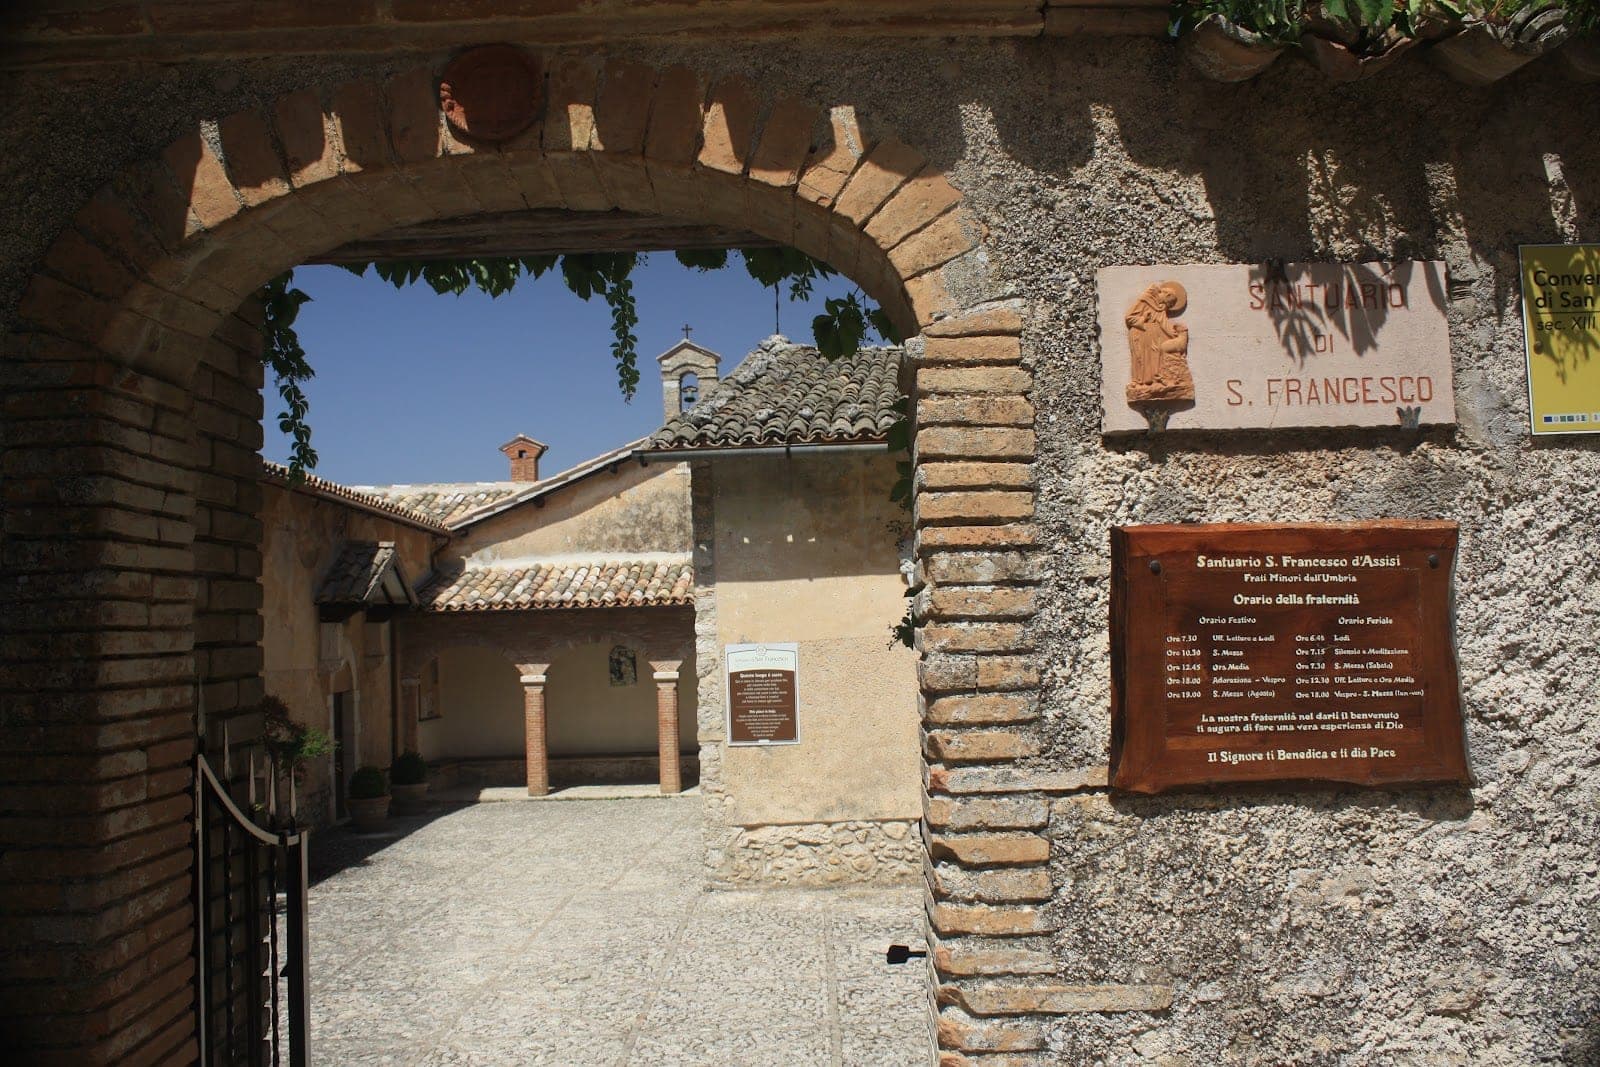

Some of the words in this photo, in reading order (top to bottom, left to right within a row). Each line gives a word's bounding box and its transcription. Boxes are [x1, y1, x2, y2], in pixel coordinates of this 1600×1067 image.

[1250, 284, 1404, 311] SANTUARIO
[1535, 292, 1552, 309] di
[1560, 292, 1595, 308] San
[1537, 319, 1566, 331] sec.
[1571, 317, 1596, 330] XIII
[1315, 334, 1334, 353] DI
[1227, 380, 1253, 406] S.
[1267, 377, 1433, 406] FRANCESCO
[1197, 555, 1261, 569] Santuario
[1265, 556, 1278, 568] S.
[1282, 556, 1348, 568] Francesco
[1352, 554, 1401, 567] d'Assisi
[1244, 573, 1266, 583] Frati
[1270, 573, 1301, 583] Minori
[1304, 573, 1357, 583] dell'Umbria
[1234, 594, 1272, 605] Orario
[1276, 594, 1303, 605] della
[1307, 594, 1360, 605] fraternità
[1199, 616, 1226, 624] Orario
[1228, 616, 1256, 624] Festivo
[1338, 617, 1364, 625] Orario
[1296, 648, 1309, 656] Ore
[1213, 664, 1227, 672] Ora
[1227, 663, 1250, 671] Media
[1262, 676, 1286, 684] Vespro
[1296, 677, 1309, 685] Ore
[1296, 691, 1309, 699] Ore
[1334, 691, 1357, 699] Vespro
[1201, 714, 1216, 723] La
[1218, 714, 1249, 723] nostra
[1251, 713, 1296, 722] fraternità
[1299, 713, 1314, 721] nel
[1316, 712, 1339, 721] darti
[1342, 712, 1348, 720] il
[1350, 712, 1400, 720] benvenuto
[1197, 725, 1204, 733] ti
[1207, 726, 1240, 735] augura
[1243, 723, 1252, 732] di
[1255, 723, 1274, 732] fare
[1277, 724, 1295, 732] una
[1321, 722, 1372, 732] esperienza
[1386, 721, 1403, 730] Dio
[1208, 752, 1217, 763] Il
[1220, 751, 1263, 765] Signore
[1266, 751, 1274, 761] ti
[1277, 749, 1328, 761] Benedica
[1331, 751, 1337, 759] e
[1340, 748, 1348, 759] ti
[1351, 748, 1368, 759] dia
[1370, 747, 1397, 759] Pace
